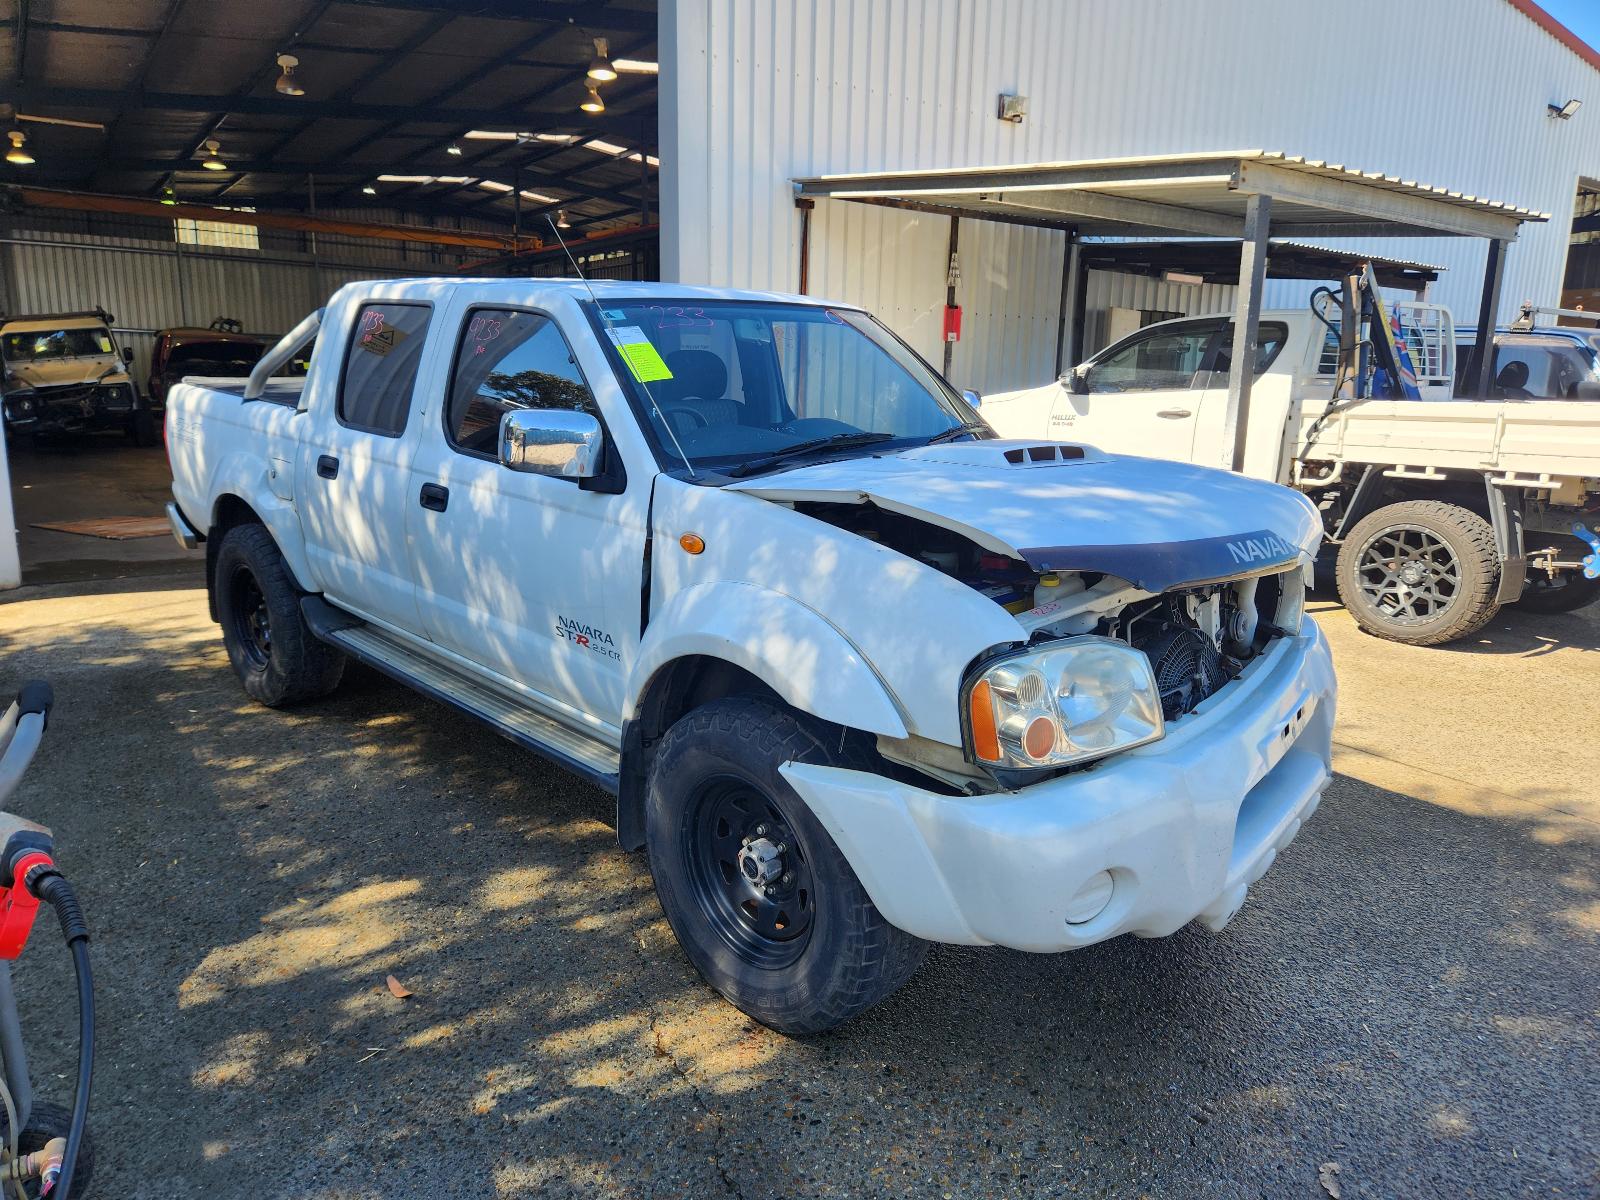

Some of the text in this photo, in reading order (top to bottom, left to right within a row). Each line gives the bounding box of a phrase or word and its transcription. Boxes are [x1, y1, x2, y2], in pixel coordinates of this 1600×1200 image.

[1226, 536, 1298, 564] NAVAR
[555, 625, 621, 662] ST-R 2.5 CR
[558, 615, 615, 647] NAVARA
